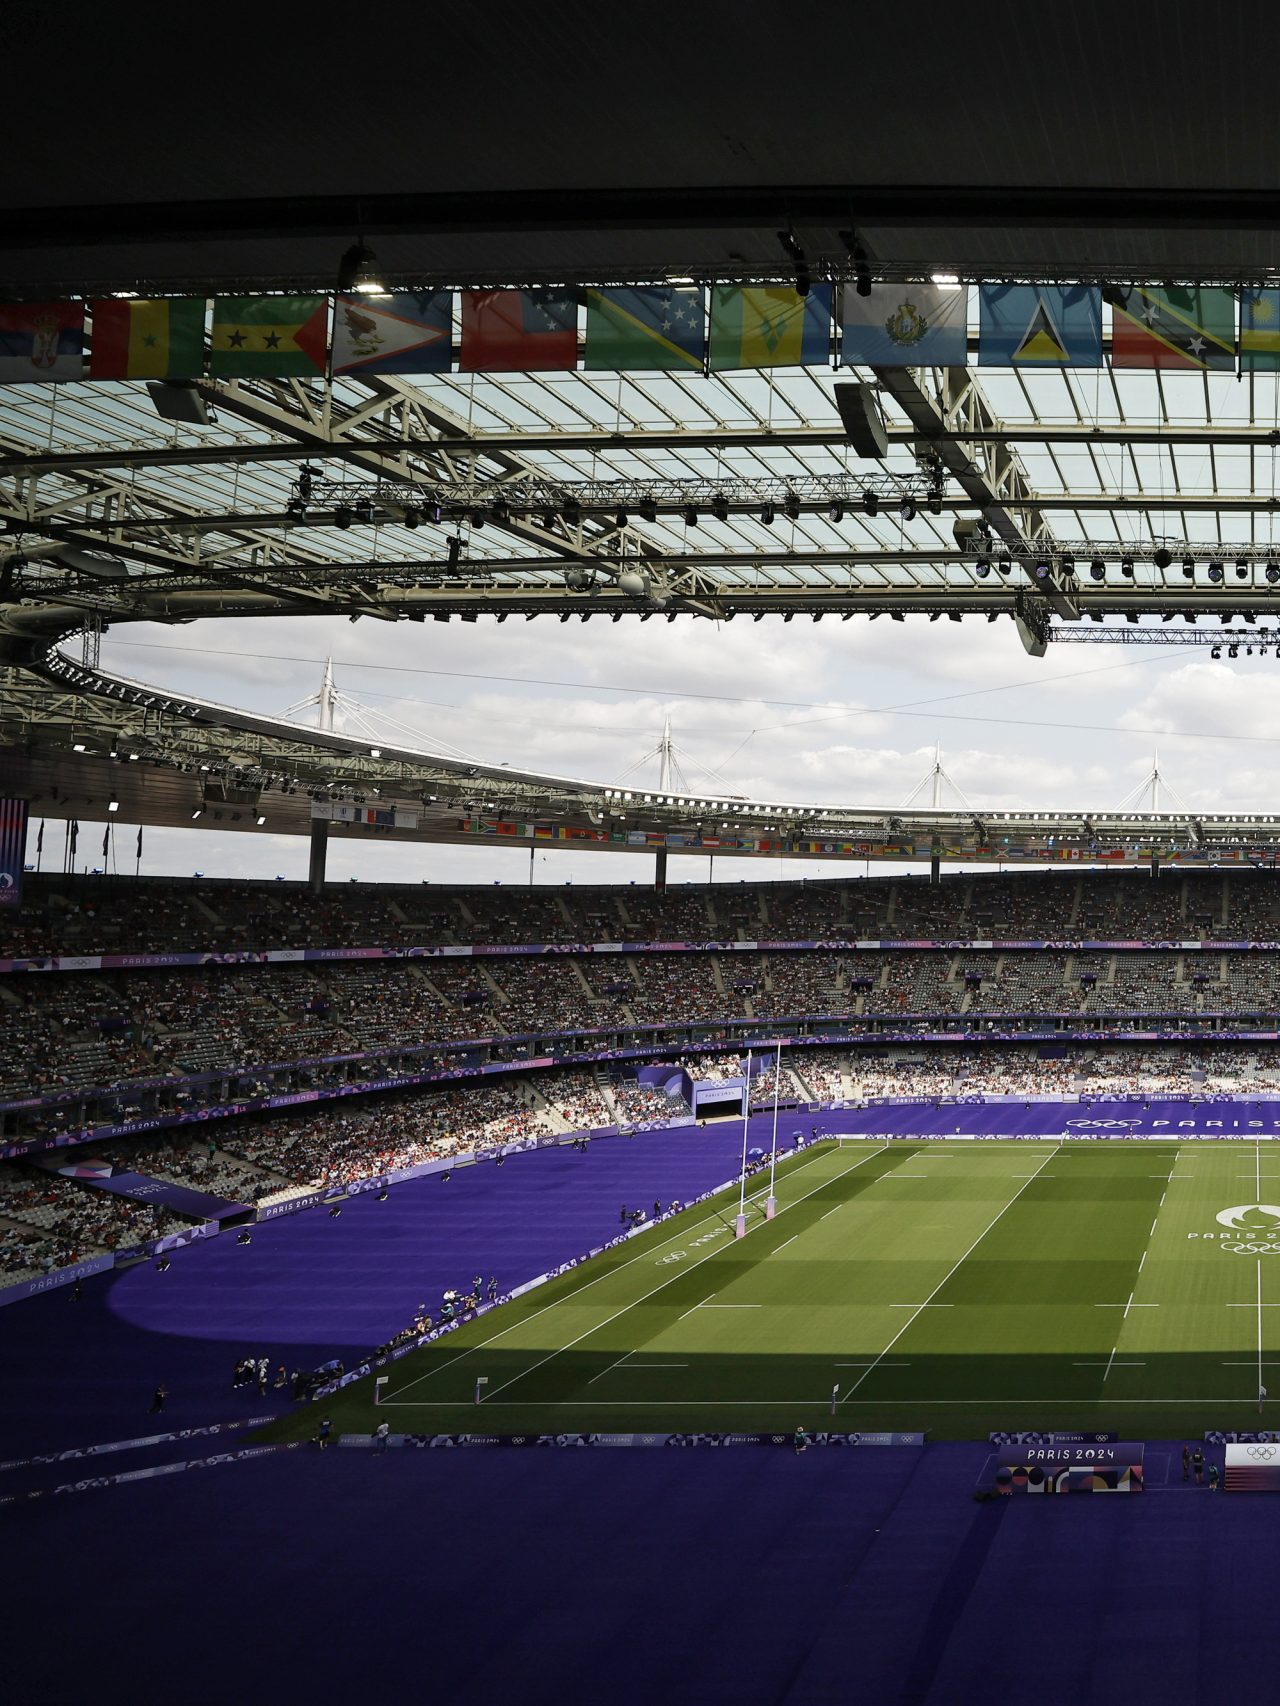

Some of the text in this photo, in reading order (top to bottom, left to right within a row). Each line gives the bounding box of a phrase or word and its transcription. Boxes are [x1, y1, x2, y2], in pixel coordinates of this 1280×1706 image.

[275, 1094, 315, 1105] PARIS 2024
[112, 1121, 160, 1133] PARIS 2024
[266, 1196, 319, 1217] PARIS 2024
[30, 1263, 101, 1292] PARIS 2024
[1027, 1449, 1114, 1460] PARIS 2024
